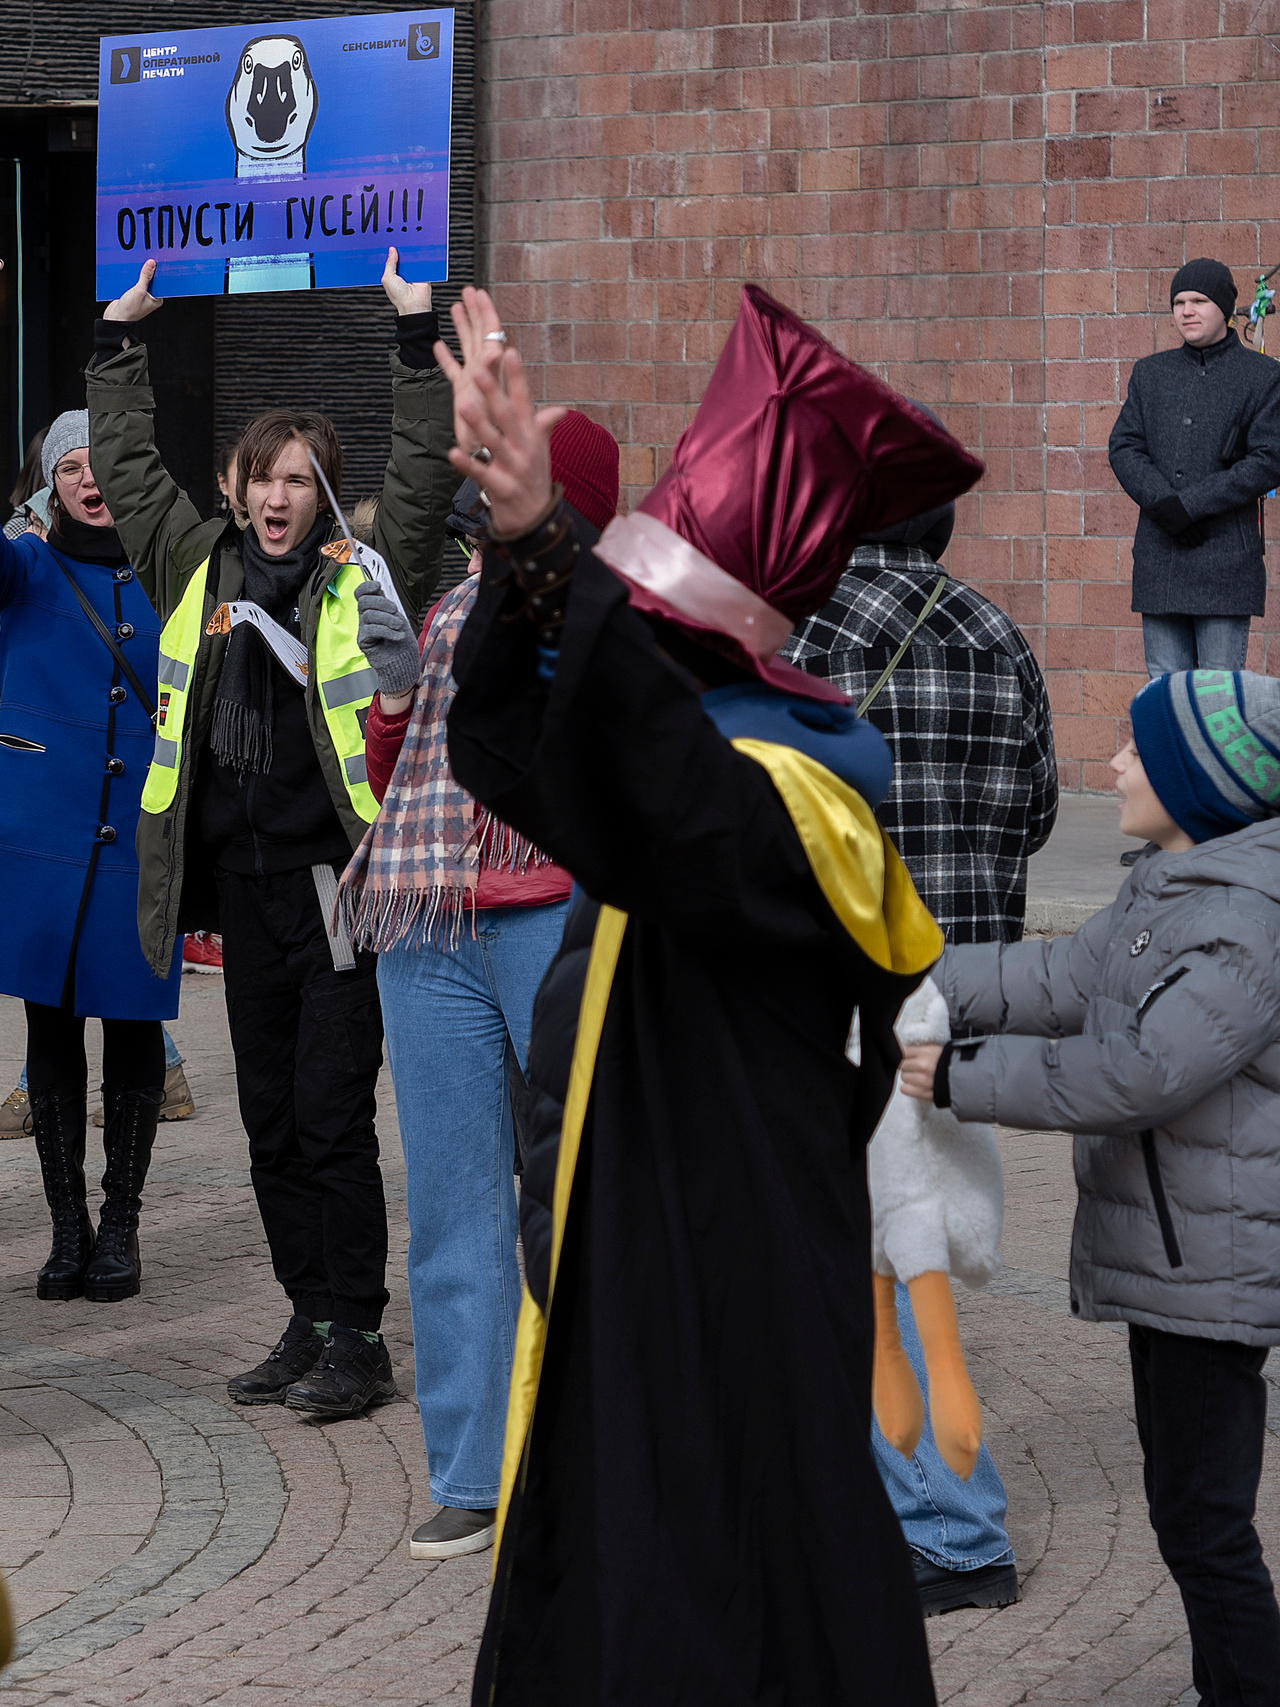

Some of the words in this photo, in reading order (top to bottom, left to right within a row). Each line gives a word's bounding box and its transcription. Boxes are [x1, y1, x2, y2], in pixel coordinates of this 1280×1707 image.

[143, 46, 178, 58] ЦЕНТР
[342, 38, 407, 52] СЕНСИВИТИ
[142, 52, 221, 69] ОПЕРАТИВНОЙ
[142, 67, 185, 80] ПЕЧАТИ
[117, 200, 255, 251] ОТПУСТИ
[285, 183, 425, 243] ГУСЕЙ!!!
